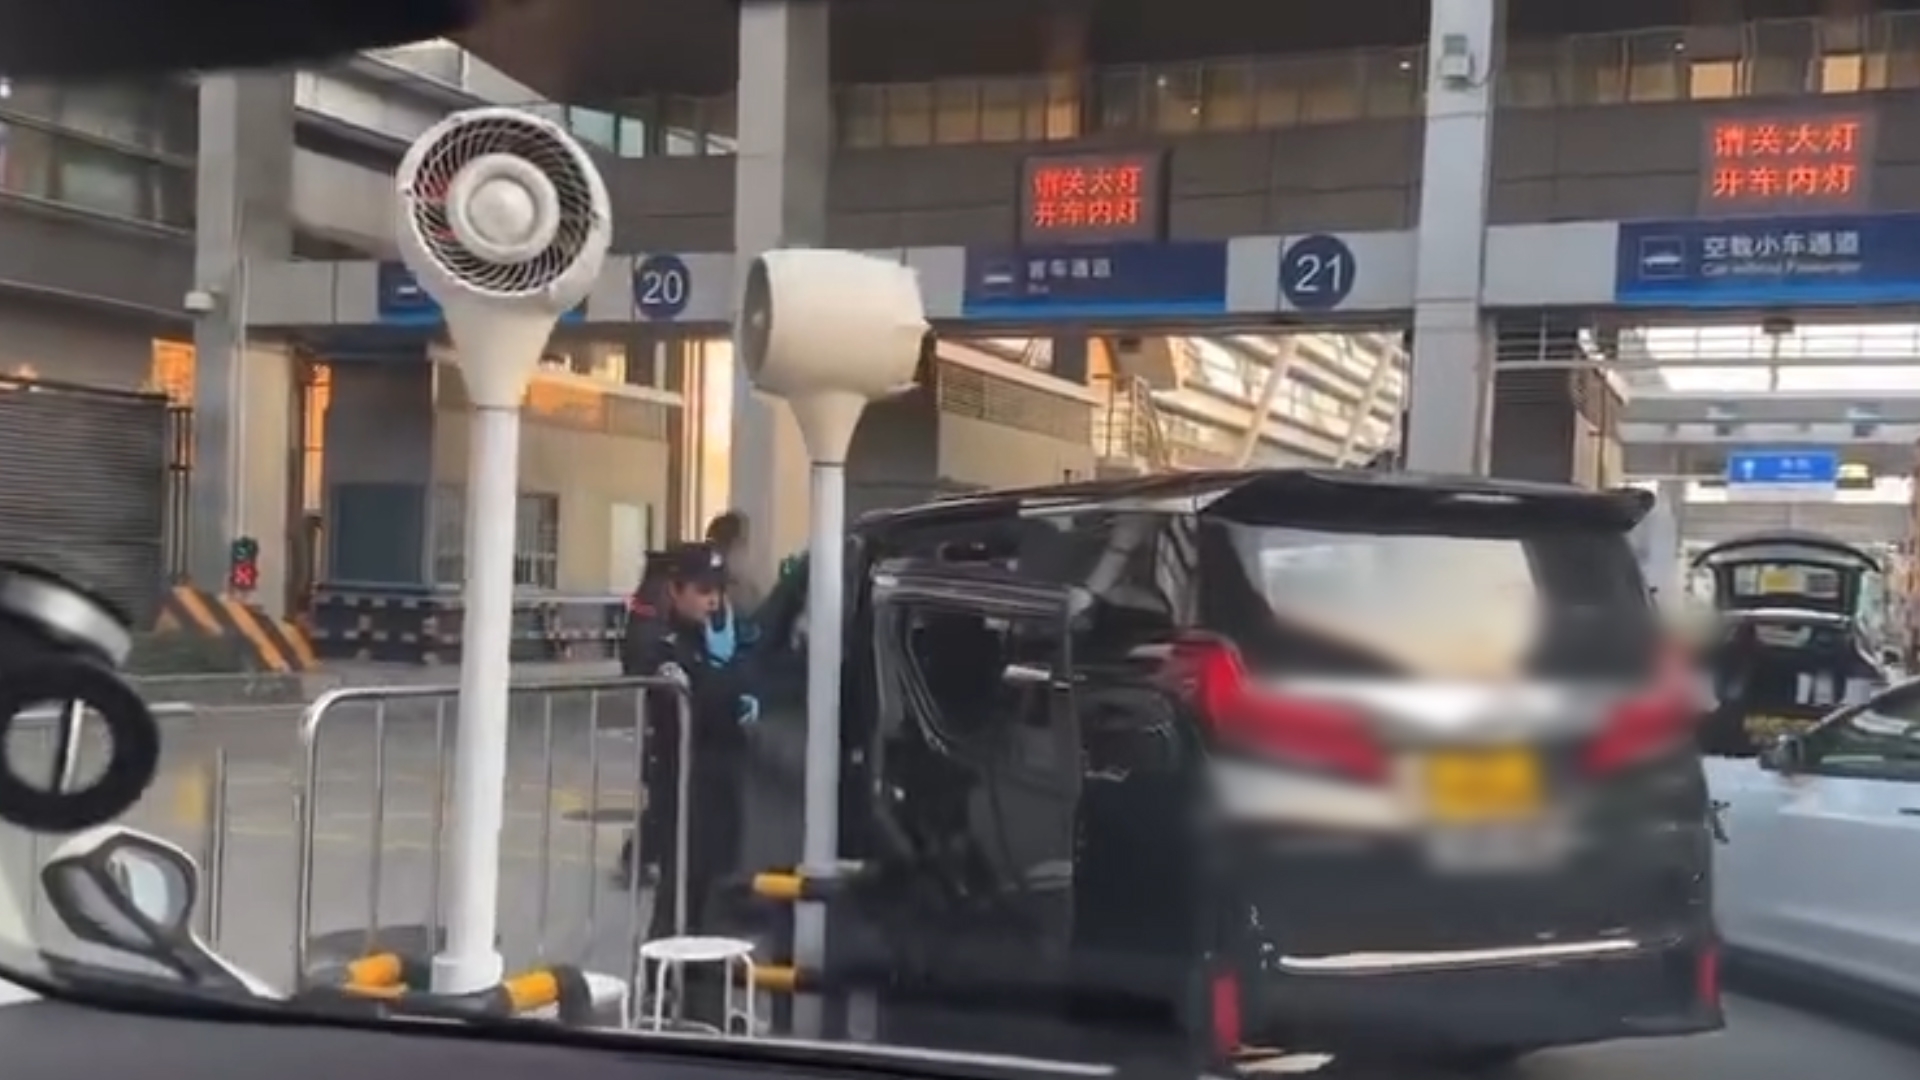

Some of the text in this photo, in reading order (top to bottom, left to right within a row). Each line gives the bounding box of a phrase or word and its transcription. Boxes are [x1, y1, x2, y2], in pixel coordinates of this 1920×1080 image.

[1714, 122, 1860, 156] 请关大灯
[1712, 163, 1856, 197] 开车内灯
[641, 269, 683, 305] 20
[1295, 253, 1341, 292] 21
